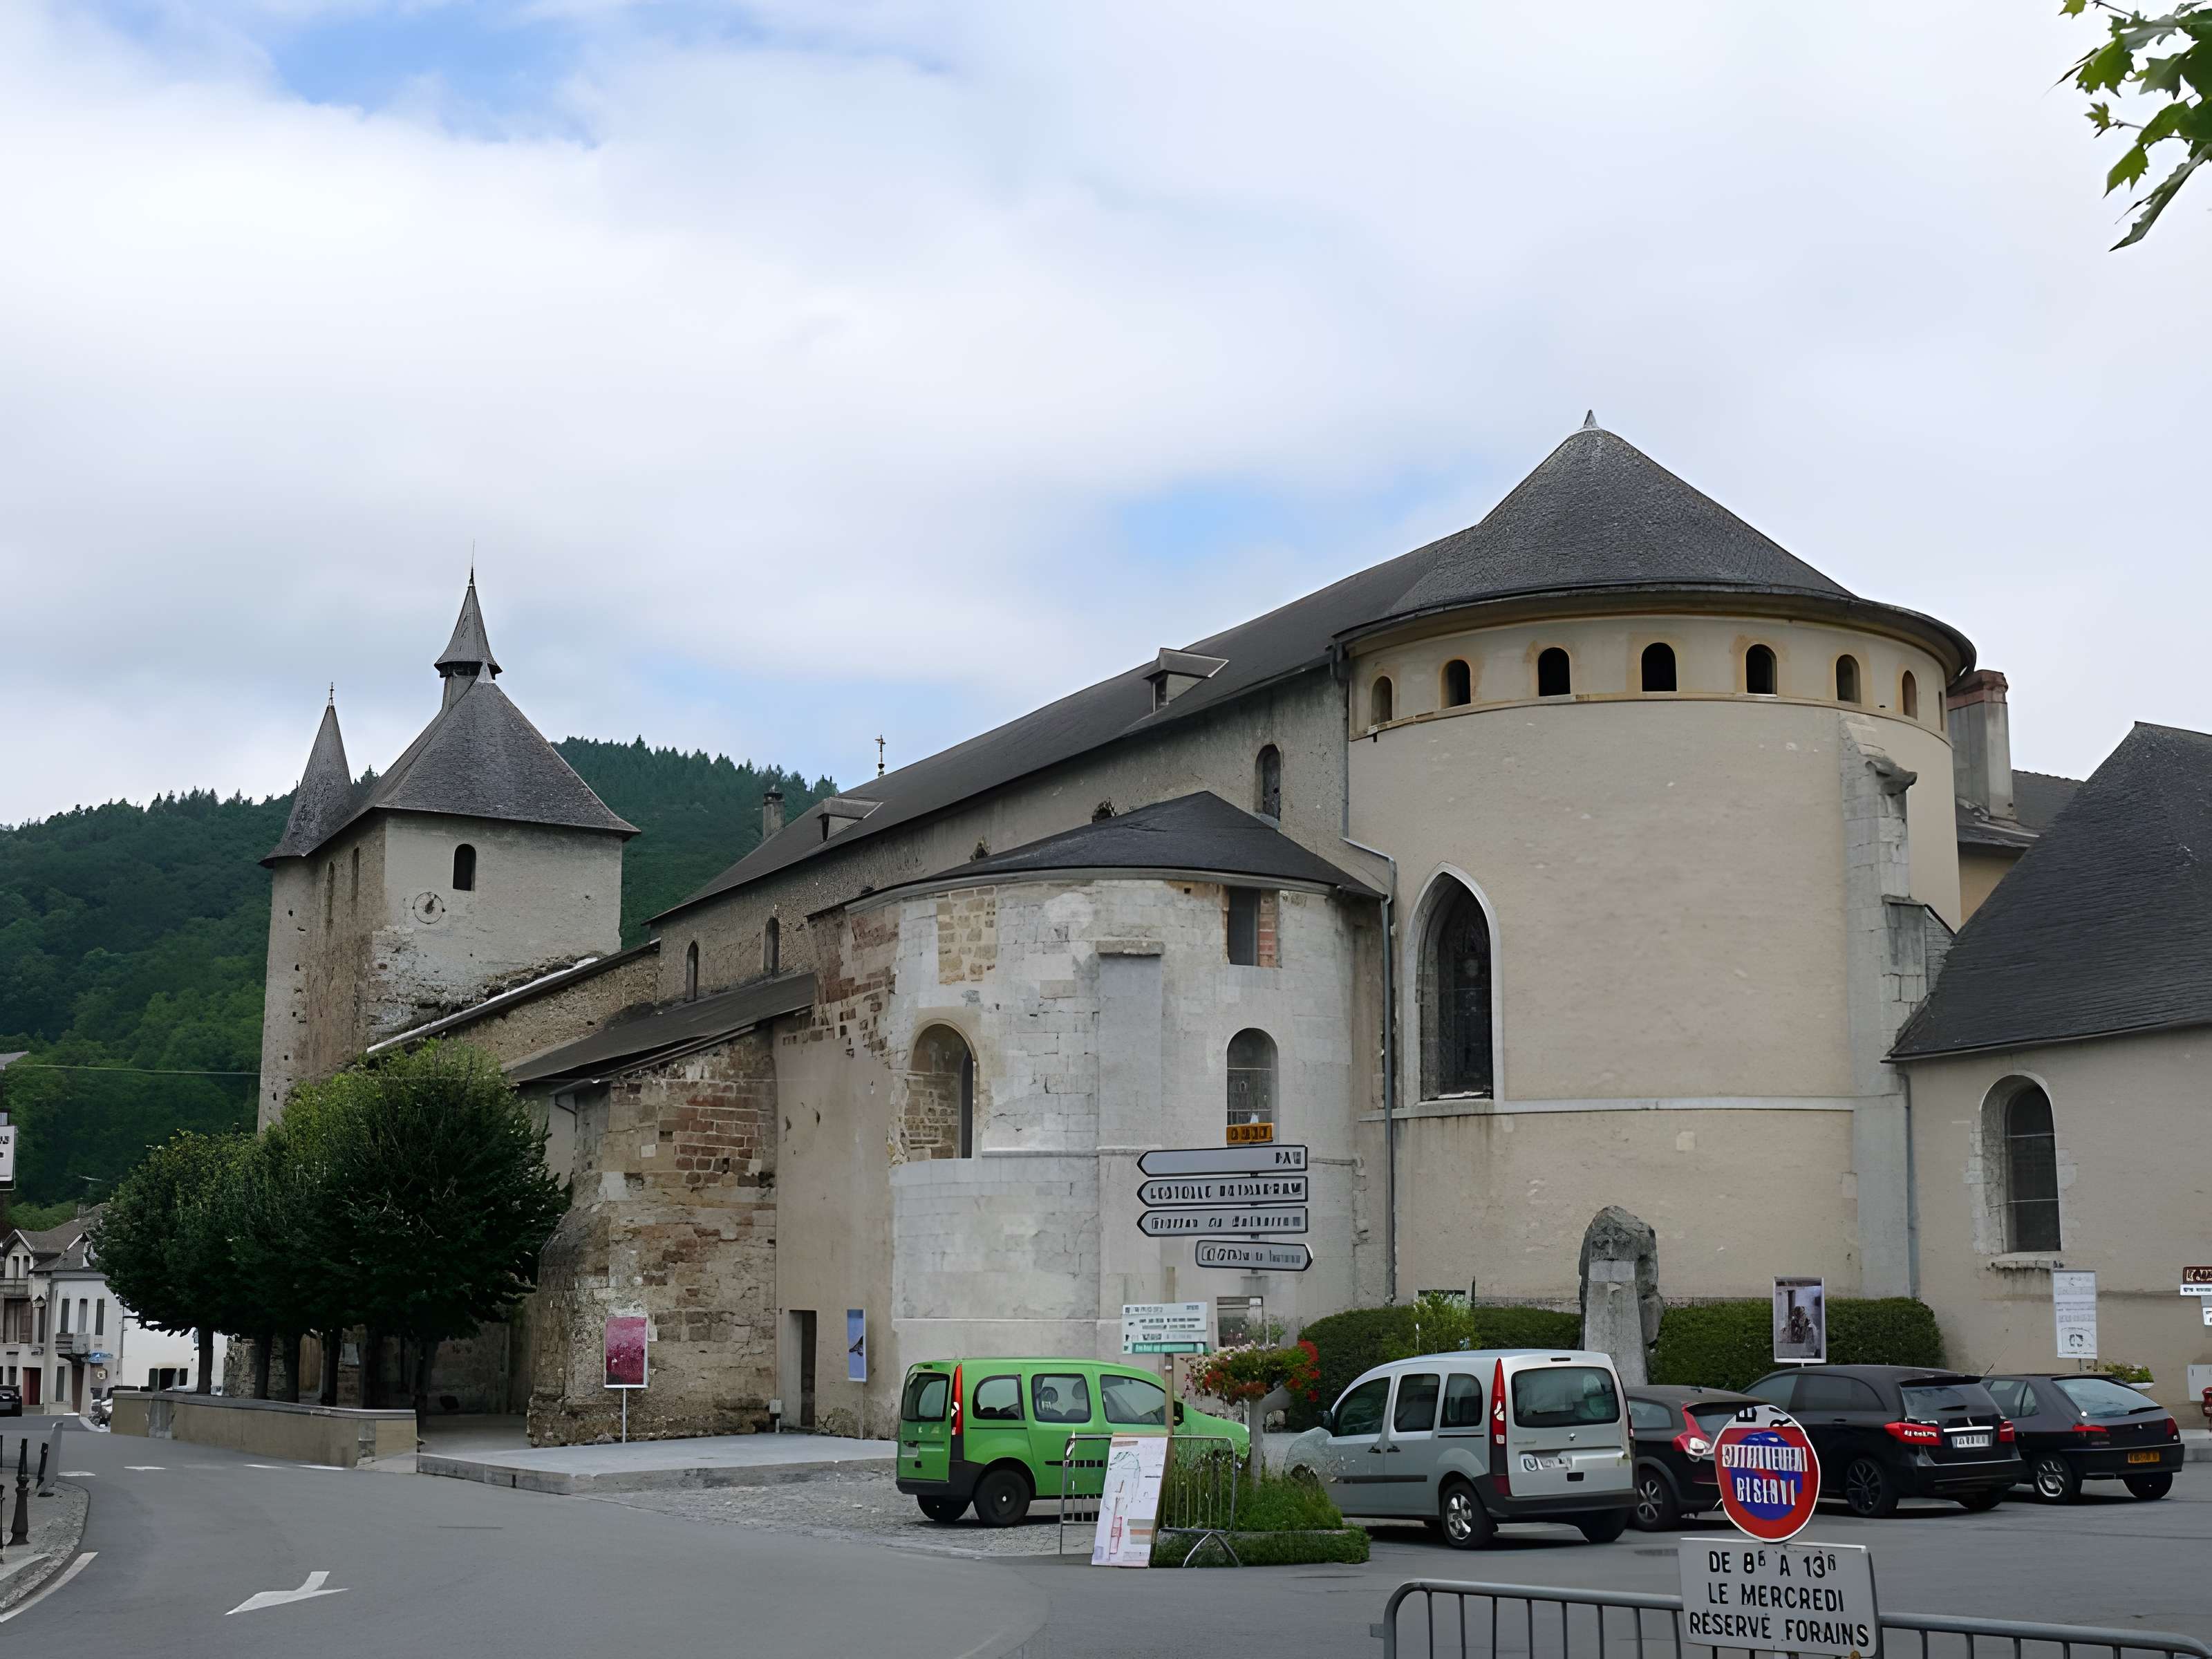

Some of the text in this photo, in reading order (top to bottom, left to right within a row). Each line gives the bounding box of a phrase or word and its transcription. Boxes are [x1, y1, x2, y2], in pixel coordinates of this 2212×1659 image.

[1709, 1550, 1732, 1573] DE
[1708, 1582, 1844, 1612] LE MERCREDI
[1785, 1618, 1869, 1647] FORAINS
